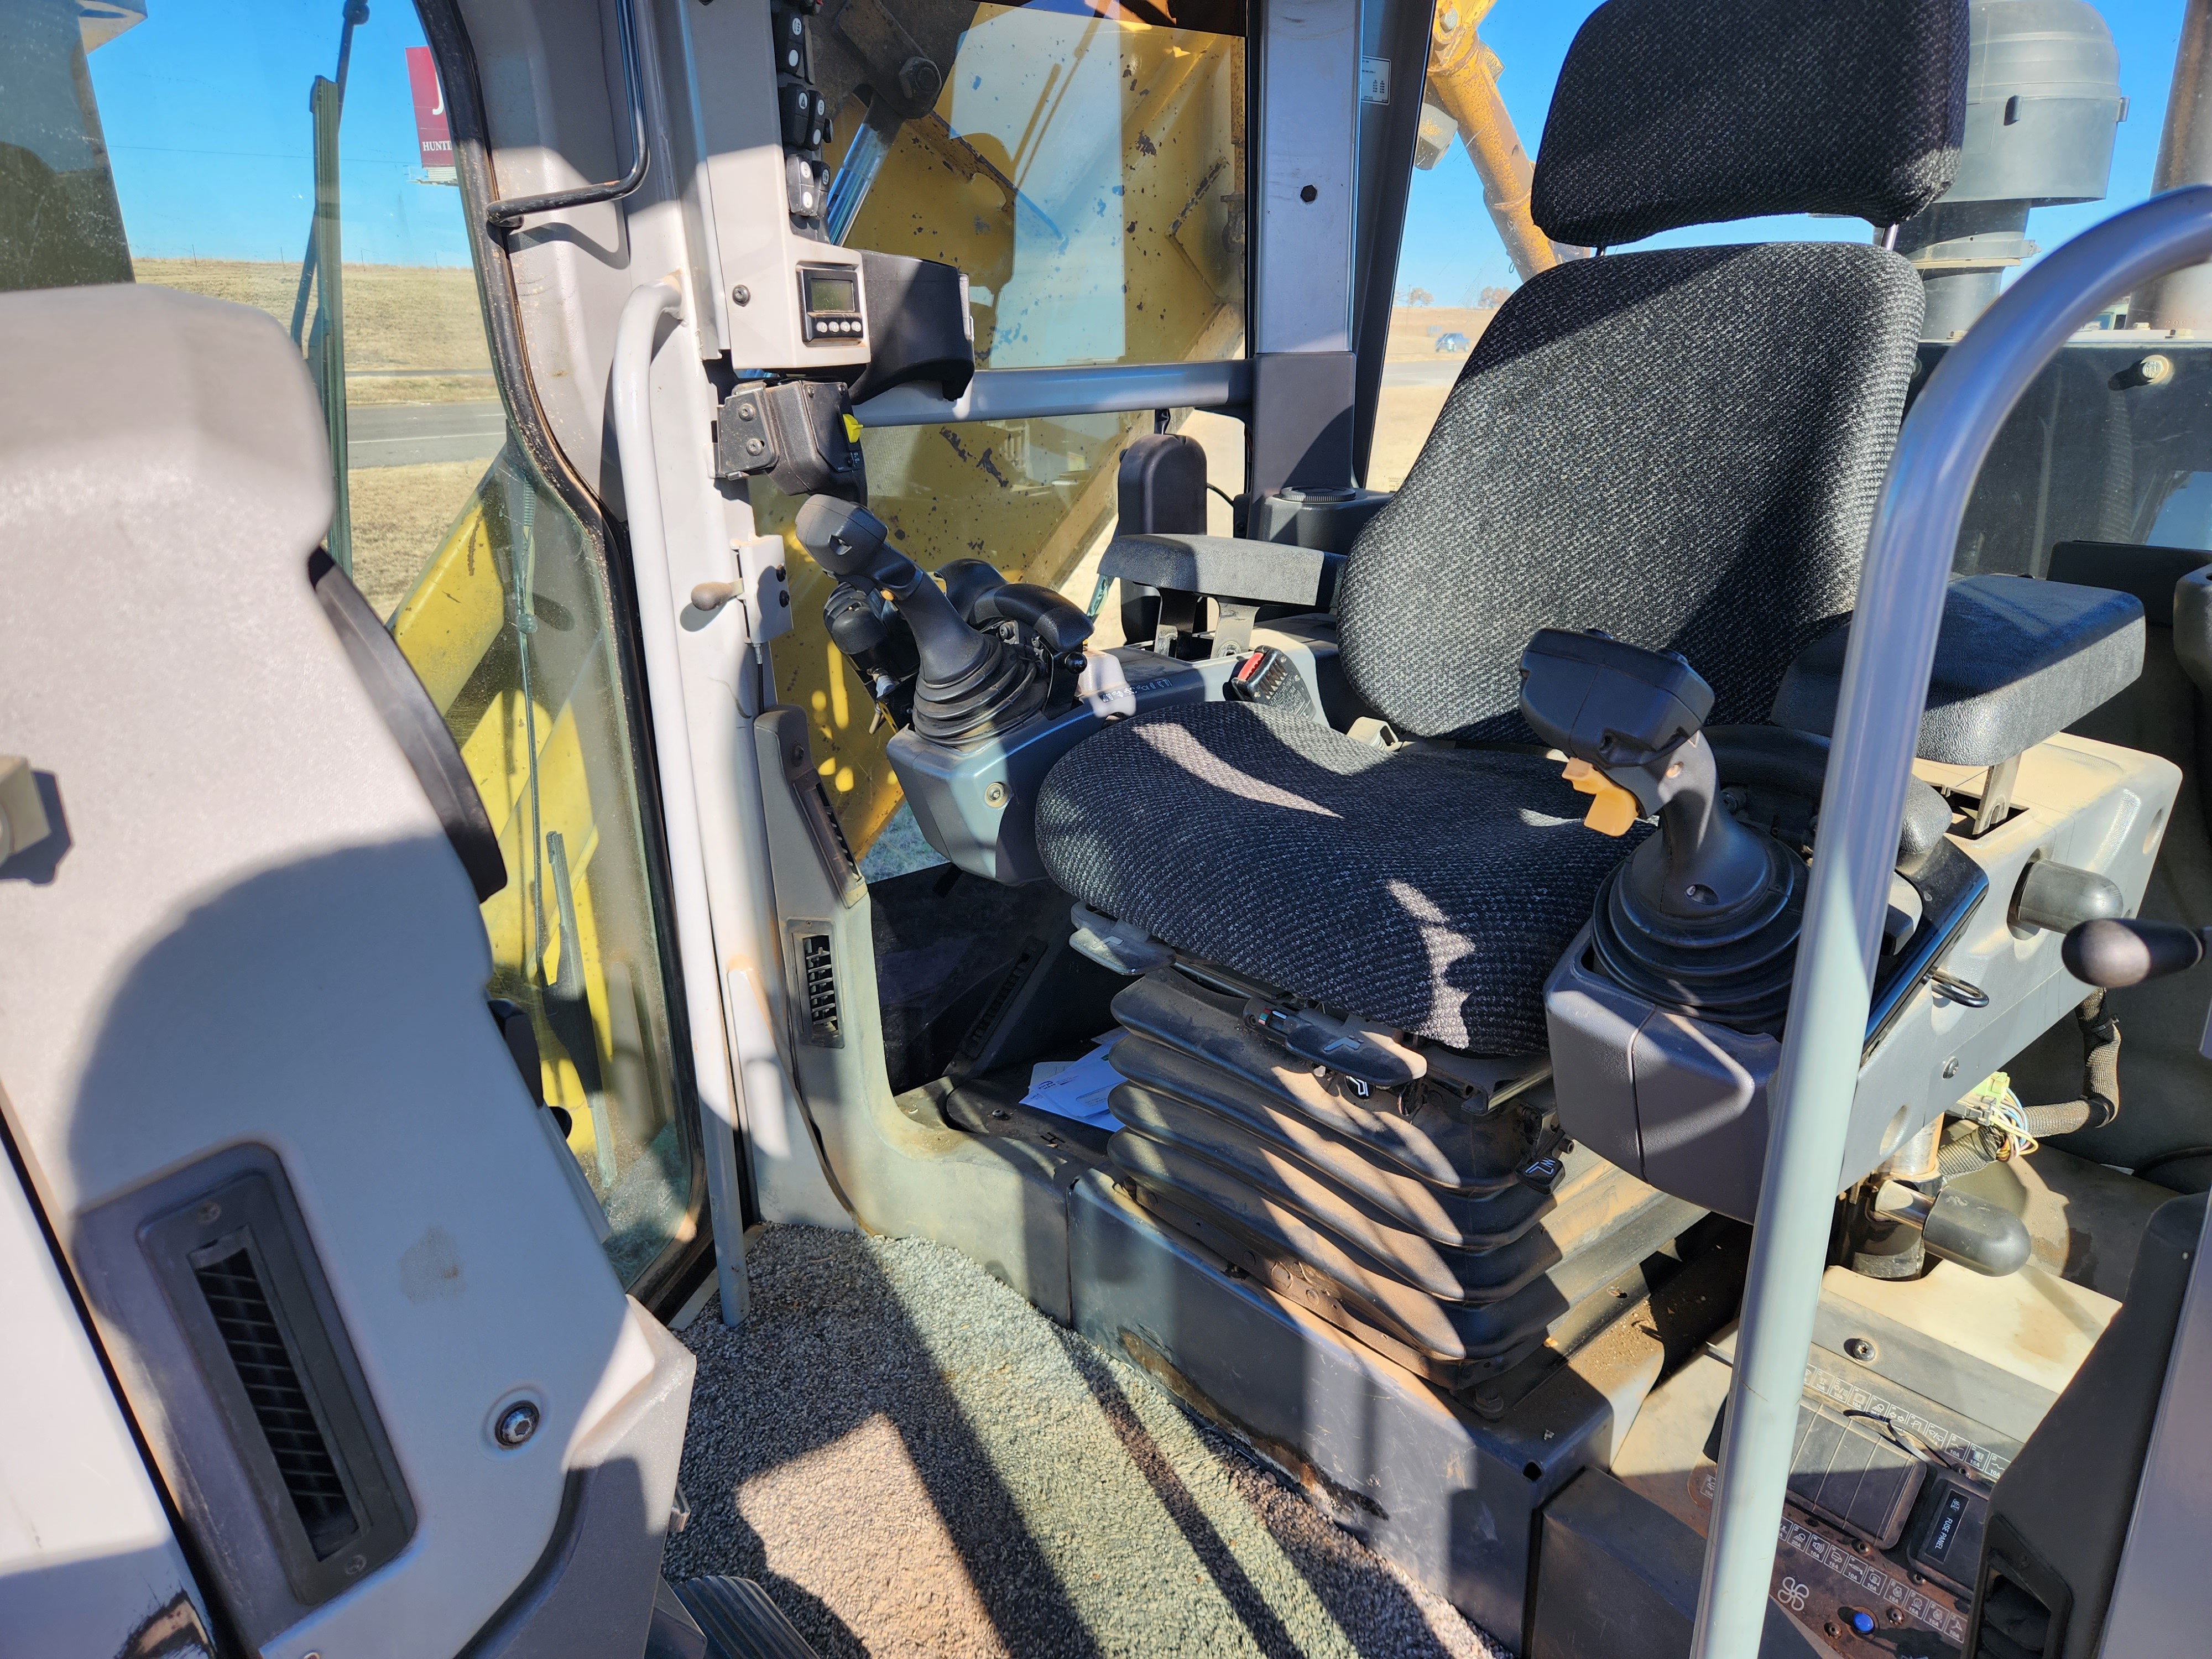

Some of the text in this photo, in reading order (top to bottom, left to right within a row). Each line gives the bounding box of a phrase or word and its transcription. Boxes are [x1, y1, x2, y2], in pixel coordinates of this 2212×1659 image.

[1949, 1449, 1960, 1458] 10A
[1970, 1459, 1980, 1468] 15A
[1934, 1517, 1953, 1550] FUSE PANEL
[1791, 1540, 1801, 1548] 20A
[1829, 1561, 1838, 1569] 15A
[1848, 1572, 1858, 1580] 10A
[1867, 1583, 1877, 1592] 10A
[1889, 1595, 1898, 1604] 15A
[1908, 1607, 1919, 1615] 15A
[1929, 1618, 1939, 1626] 15A
